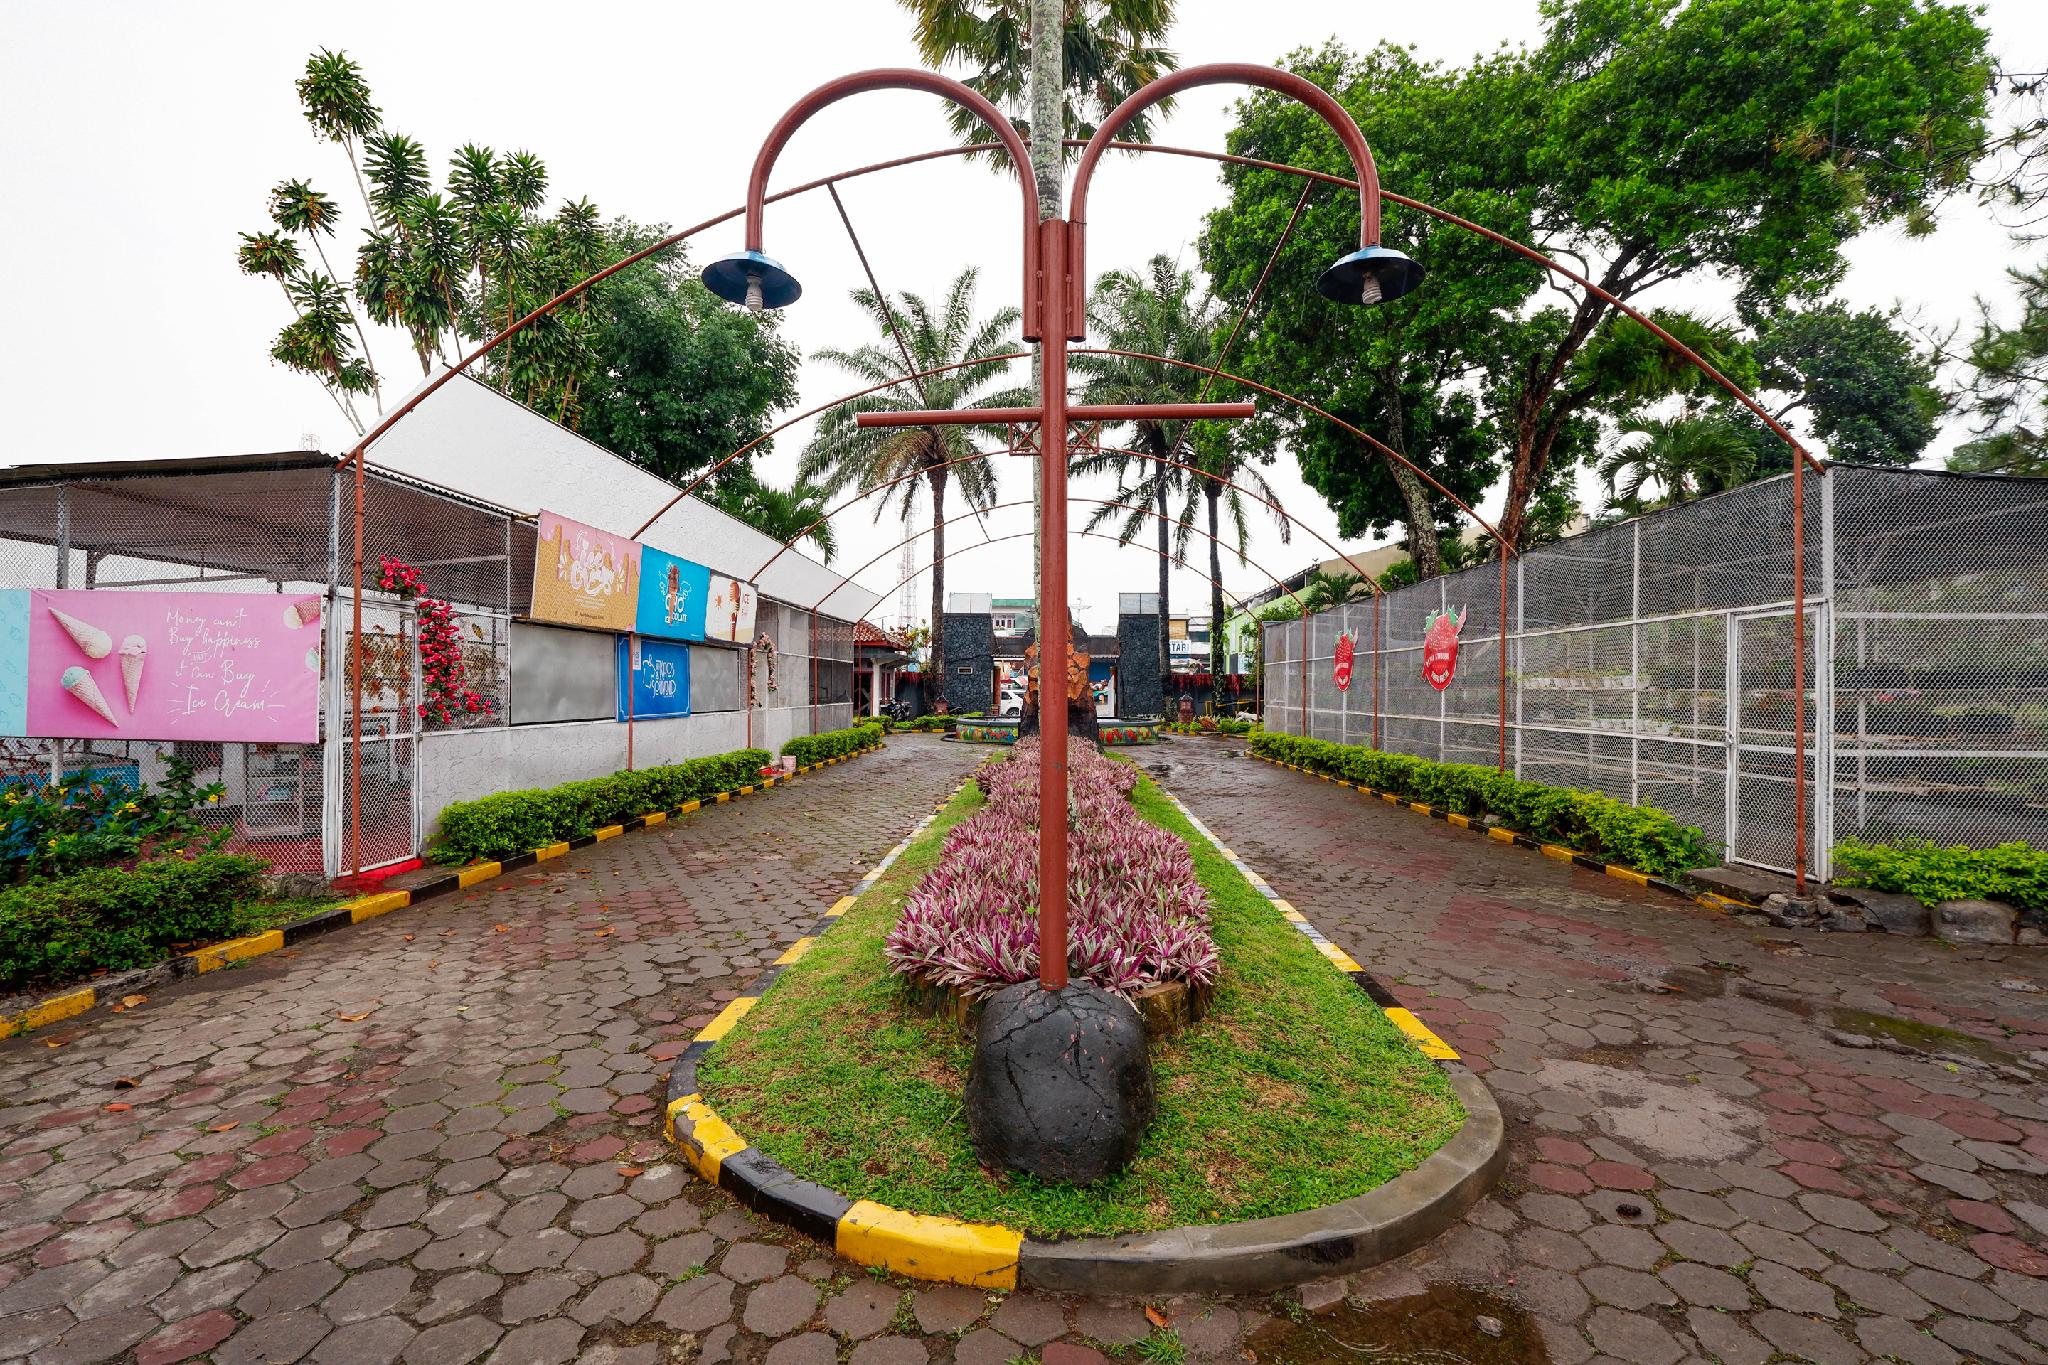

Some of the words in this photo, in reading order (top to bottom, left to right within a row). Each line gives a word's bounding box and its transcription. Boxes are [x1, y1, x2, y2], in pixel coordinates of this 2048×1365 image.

[166, 607, 207, 636] Money
[168, 627, 194, 655] Buy
[202, 628, 261, 658] happiness
[1169, 643, 1190, 651] TARI
[220, 659, 256, 698] Buy
[182, 685, 207, 715] Ice
[214, 689, 265, 717] Cream
